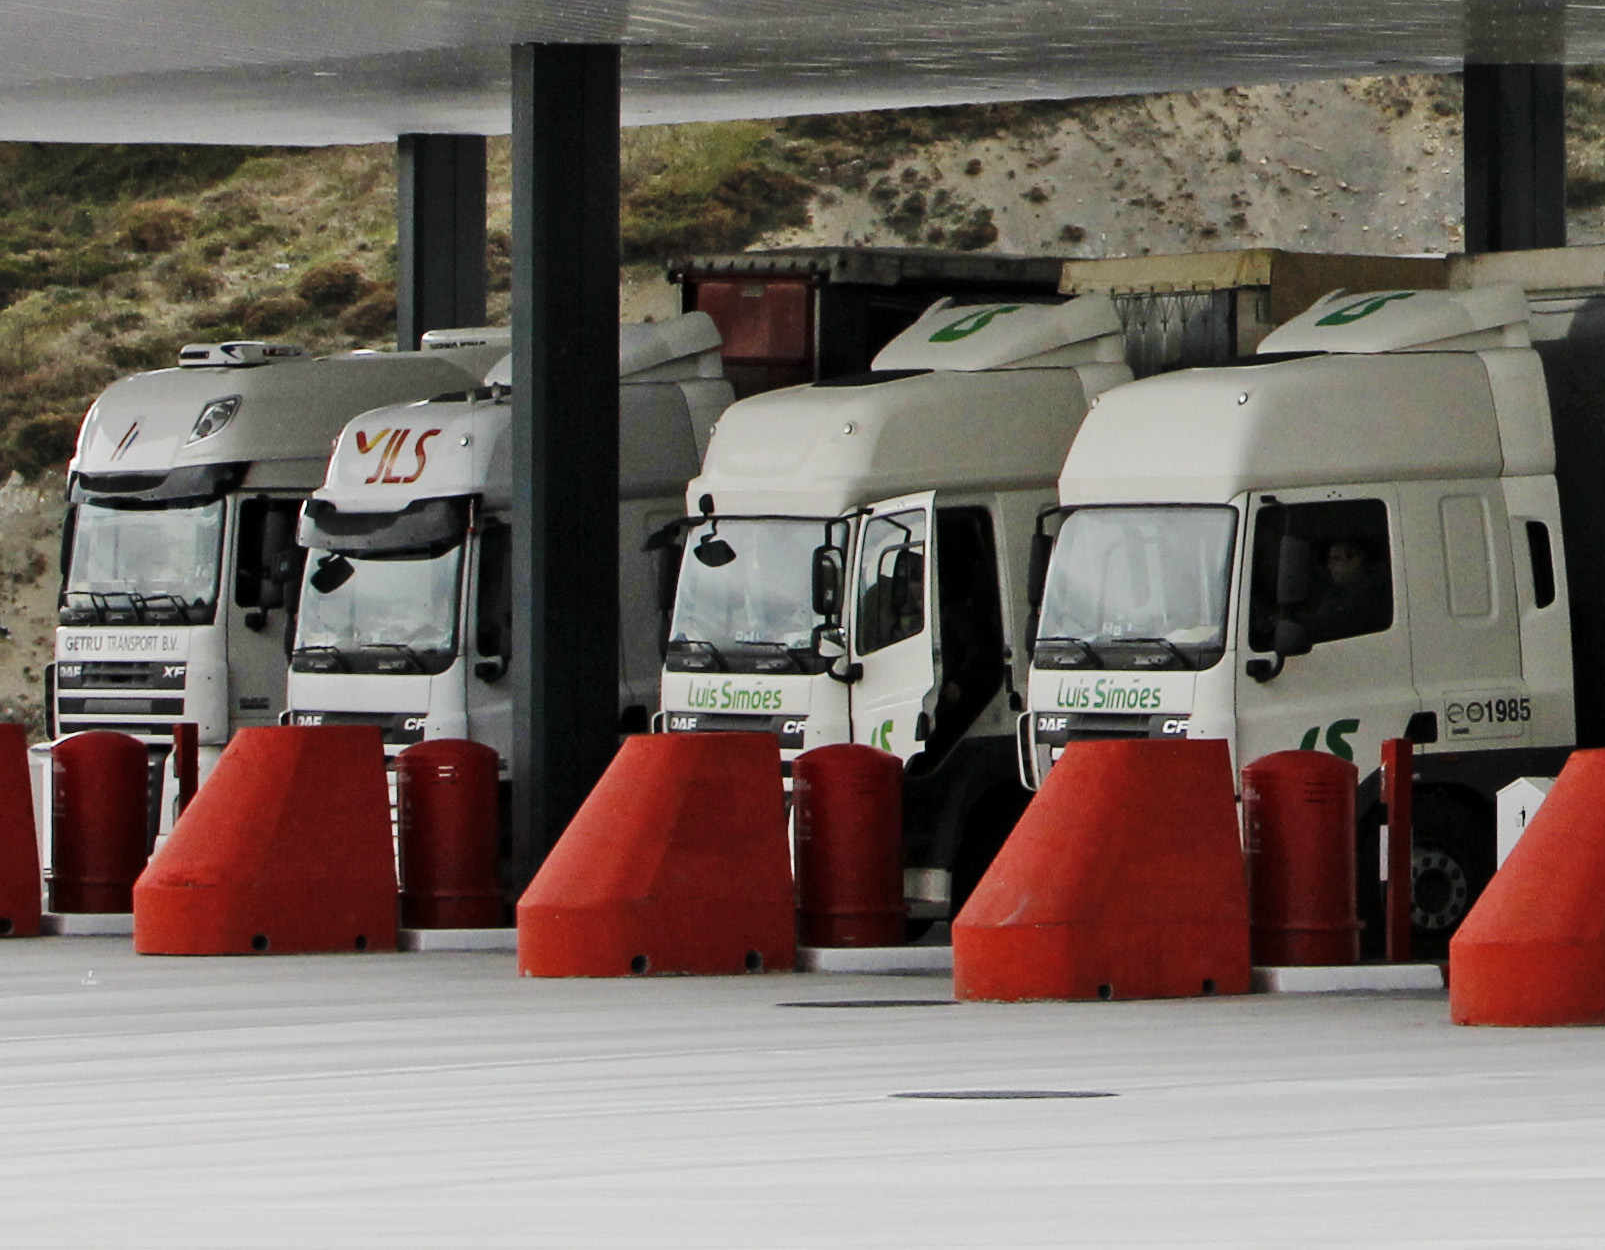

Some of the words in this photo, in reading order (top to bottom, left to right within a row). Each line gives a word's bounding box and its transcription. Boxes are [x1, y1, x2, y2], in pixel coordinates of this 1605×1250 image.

[65, 635, 102, 651] GETRU
[107, 635, 158, 651] TRANSPORT
[162, 665, 187, 678] XF
[1484, 697, 1532, 723] 1985
[670, 717, 698, 730] DAF
[1037, 717, 1068, 731] DAF
[1162, 719, 1189, 735] CF
